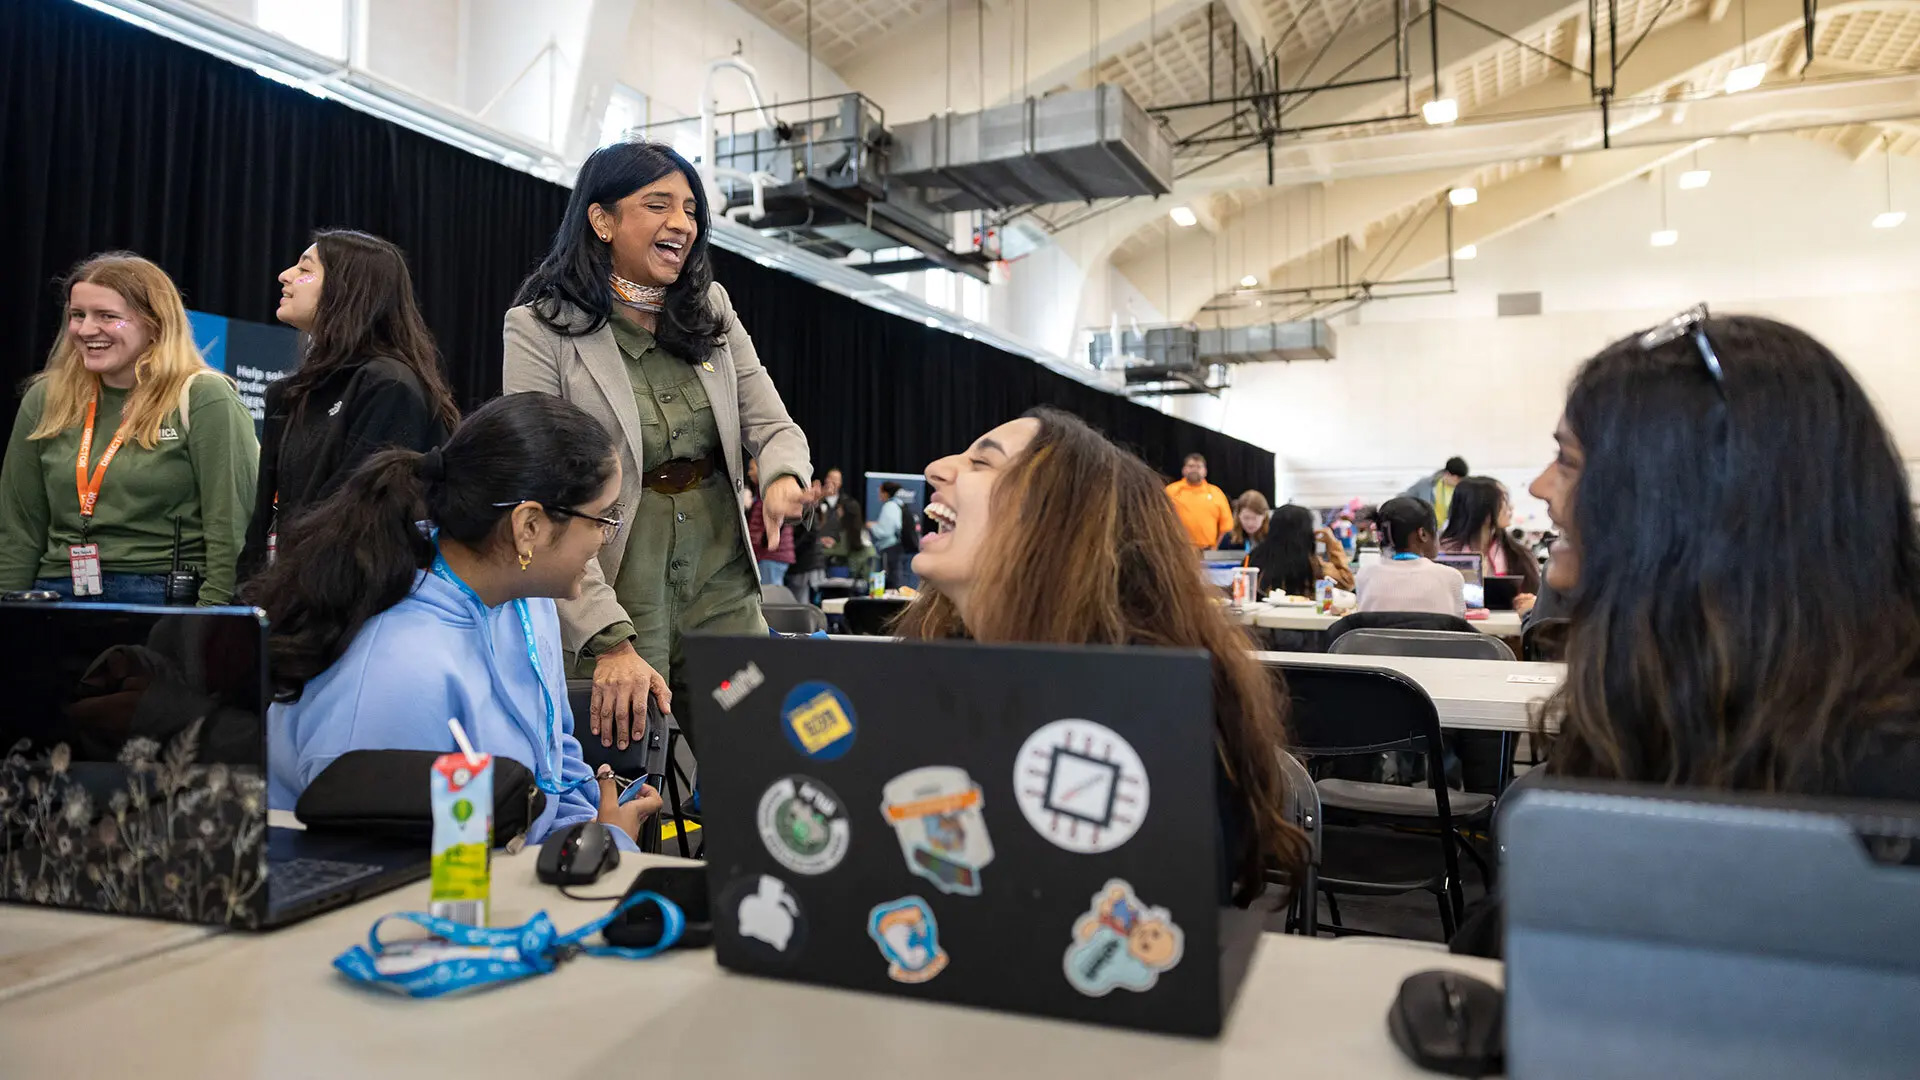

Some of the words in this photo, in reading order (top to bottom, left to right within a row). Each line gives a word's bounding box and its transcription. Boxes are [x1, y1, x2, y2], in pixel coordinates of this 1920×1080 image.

[237, 365, 264, 381] Help
[265, 370, 284, 381] sol
[158, 428, 177, 437] ICA
[79, 428, 92, 467] DIRECTOR
[100, 433, 125, 467] DIRECTO
